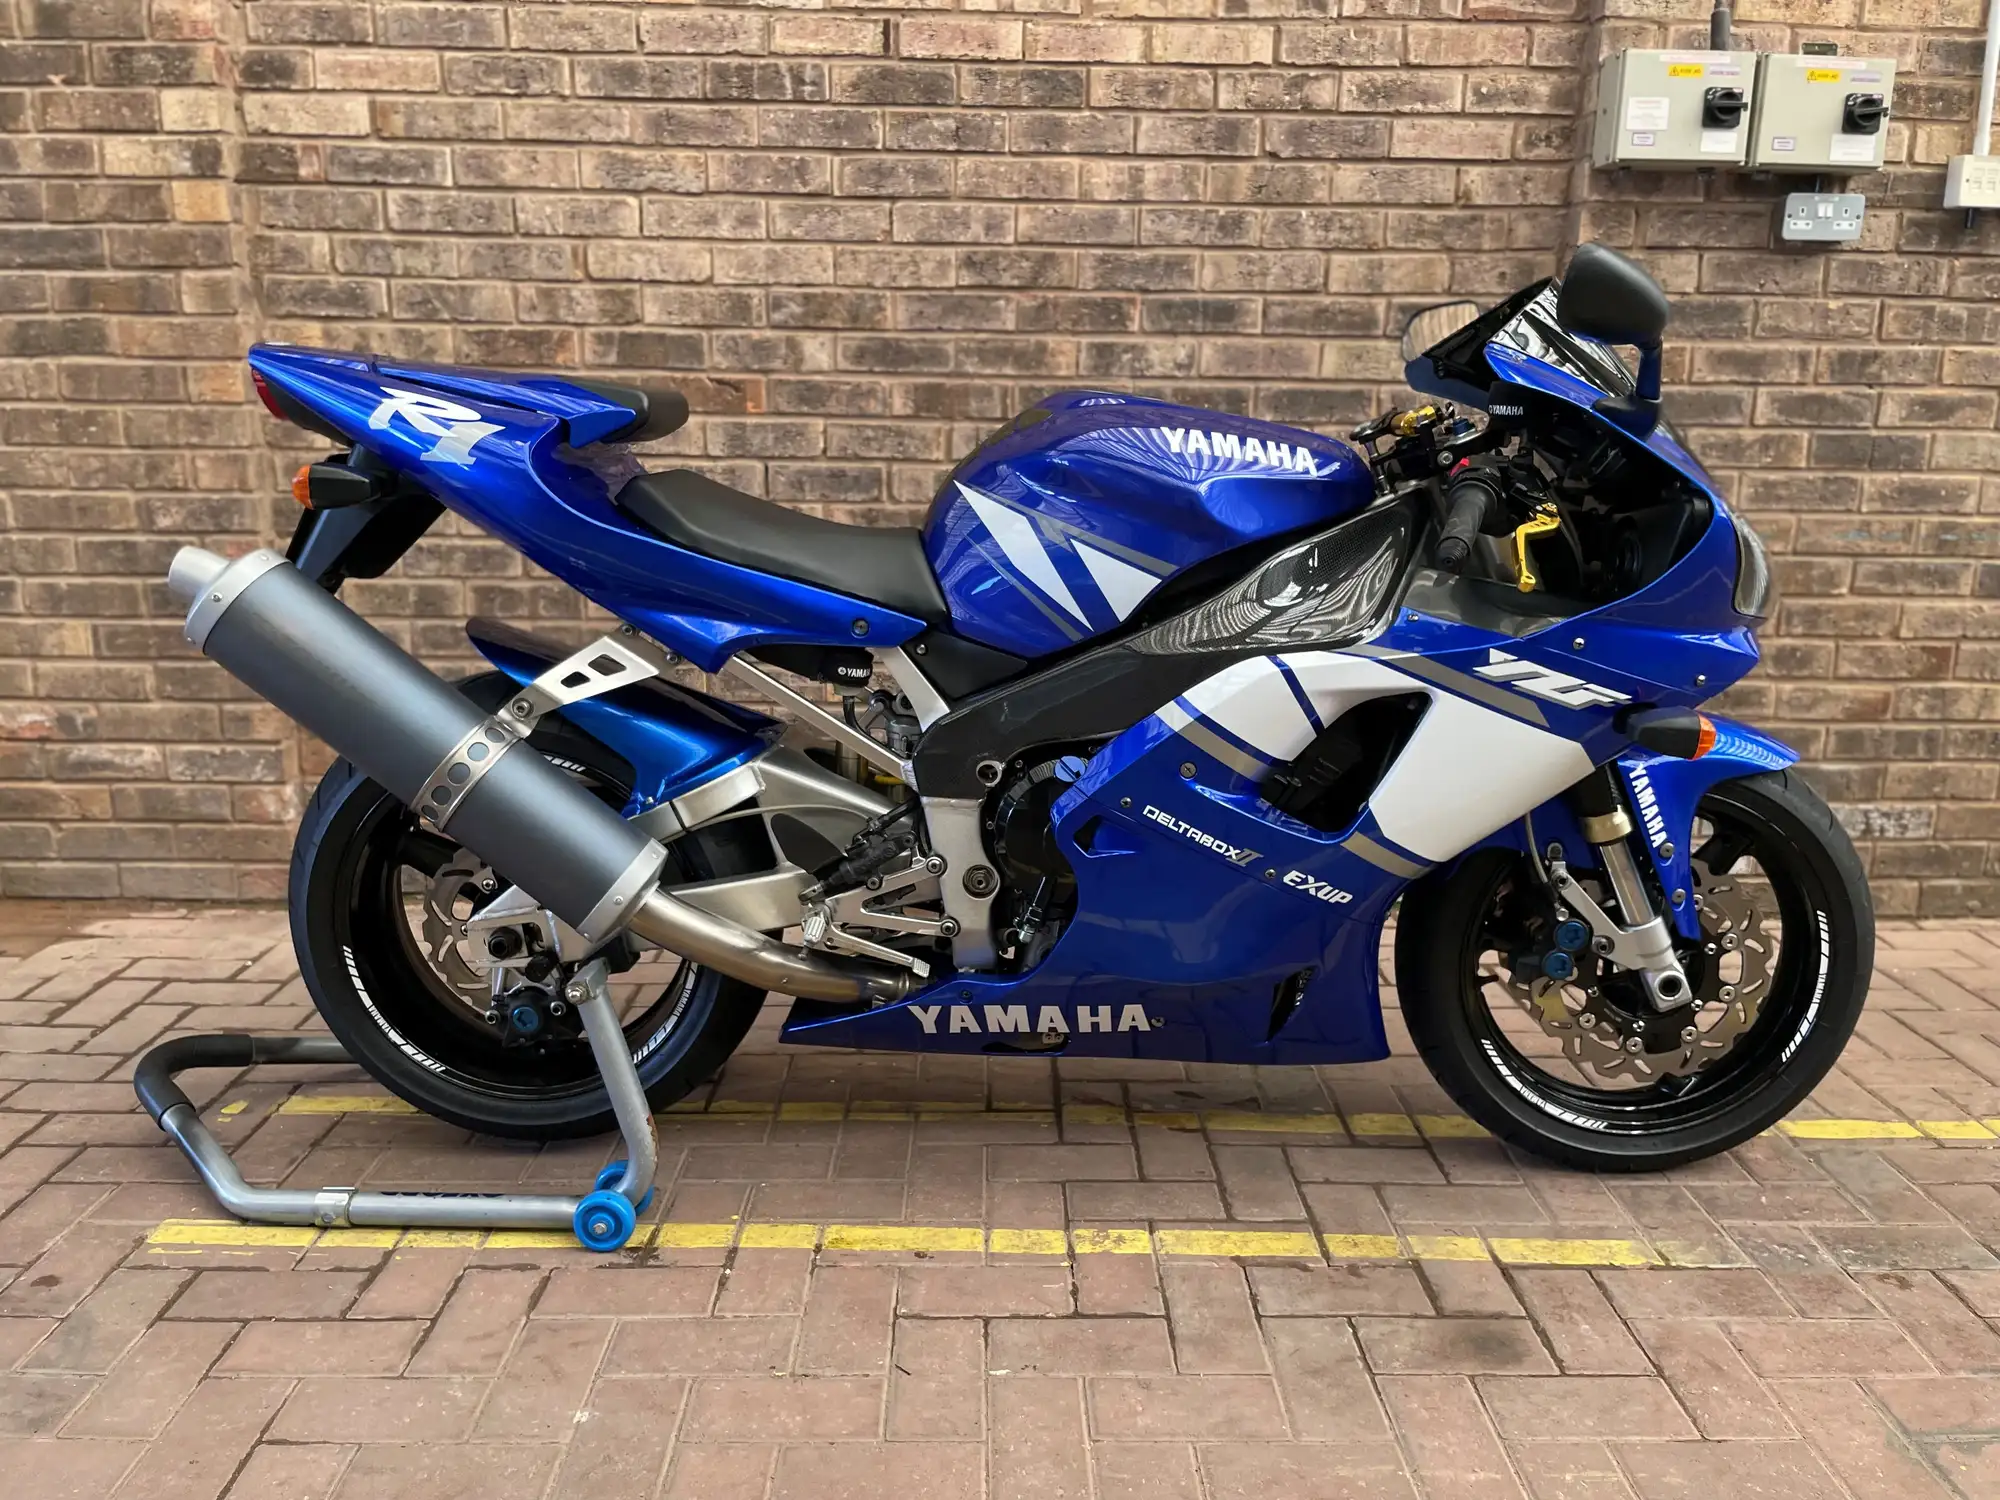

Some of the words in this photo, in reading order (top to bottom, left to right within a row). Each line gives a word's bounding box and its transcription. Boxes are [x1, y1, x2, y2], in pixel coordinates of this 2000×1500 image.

[368, 386, 506, 465] R1
[1493, 404, 1524, 416] YAMAHA
[1160, 426, 1318, 477] YAMAHA
[1628, 762, 1668, 848] YAMAHA
[1282, 869, 1354, 905] EXUP
[368, 1004, 391, 1033] YAMAHA
[907, 1003, 1151, 1034] YAMAHA
